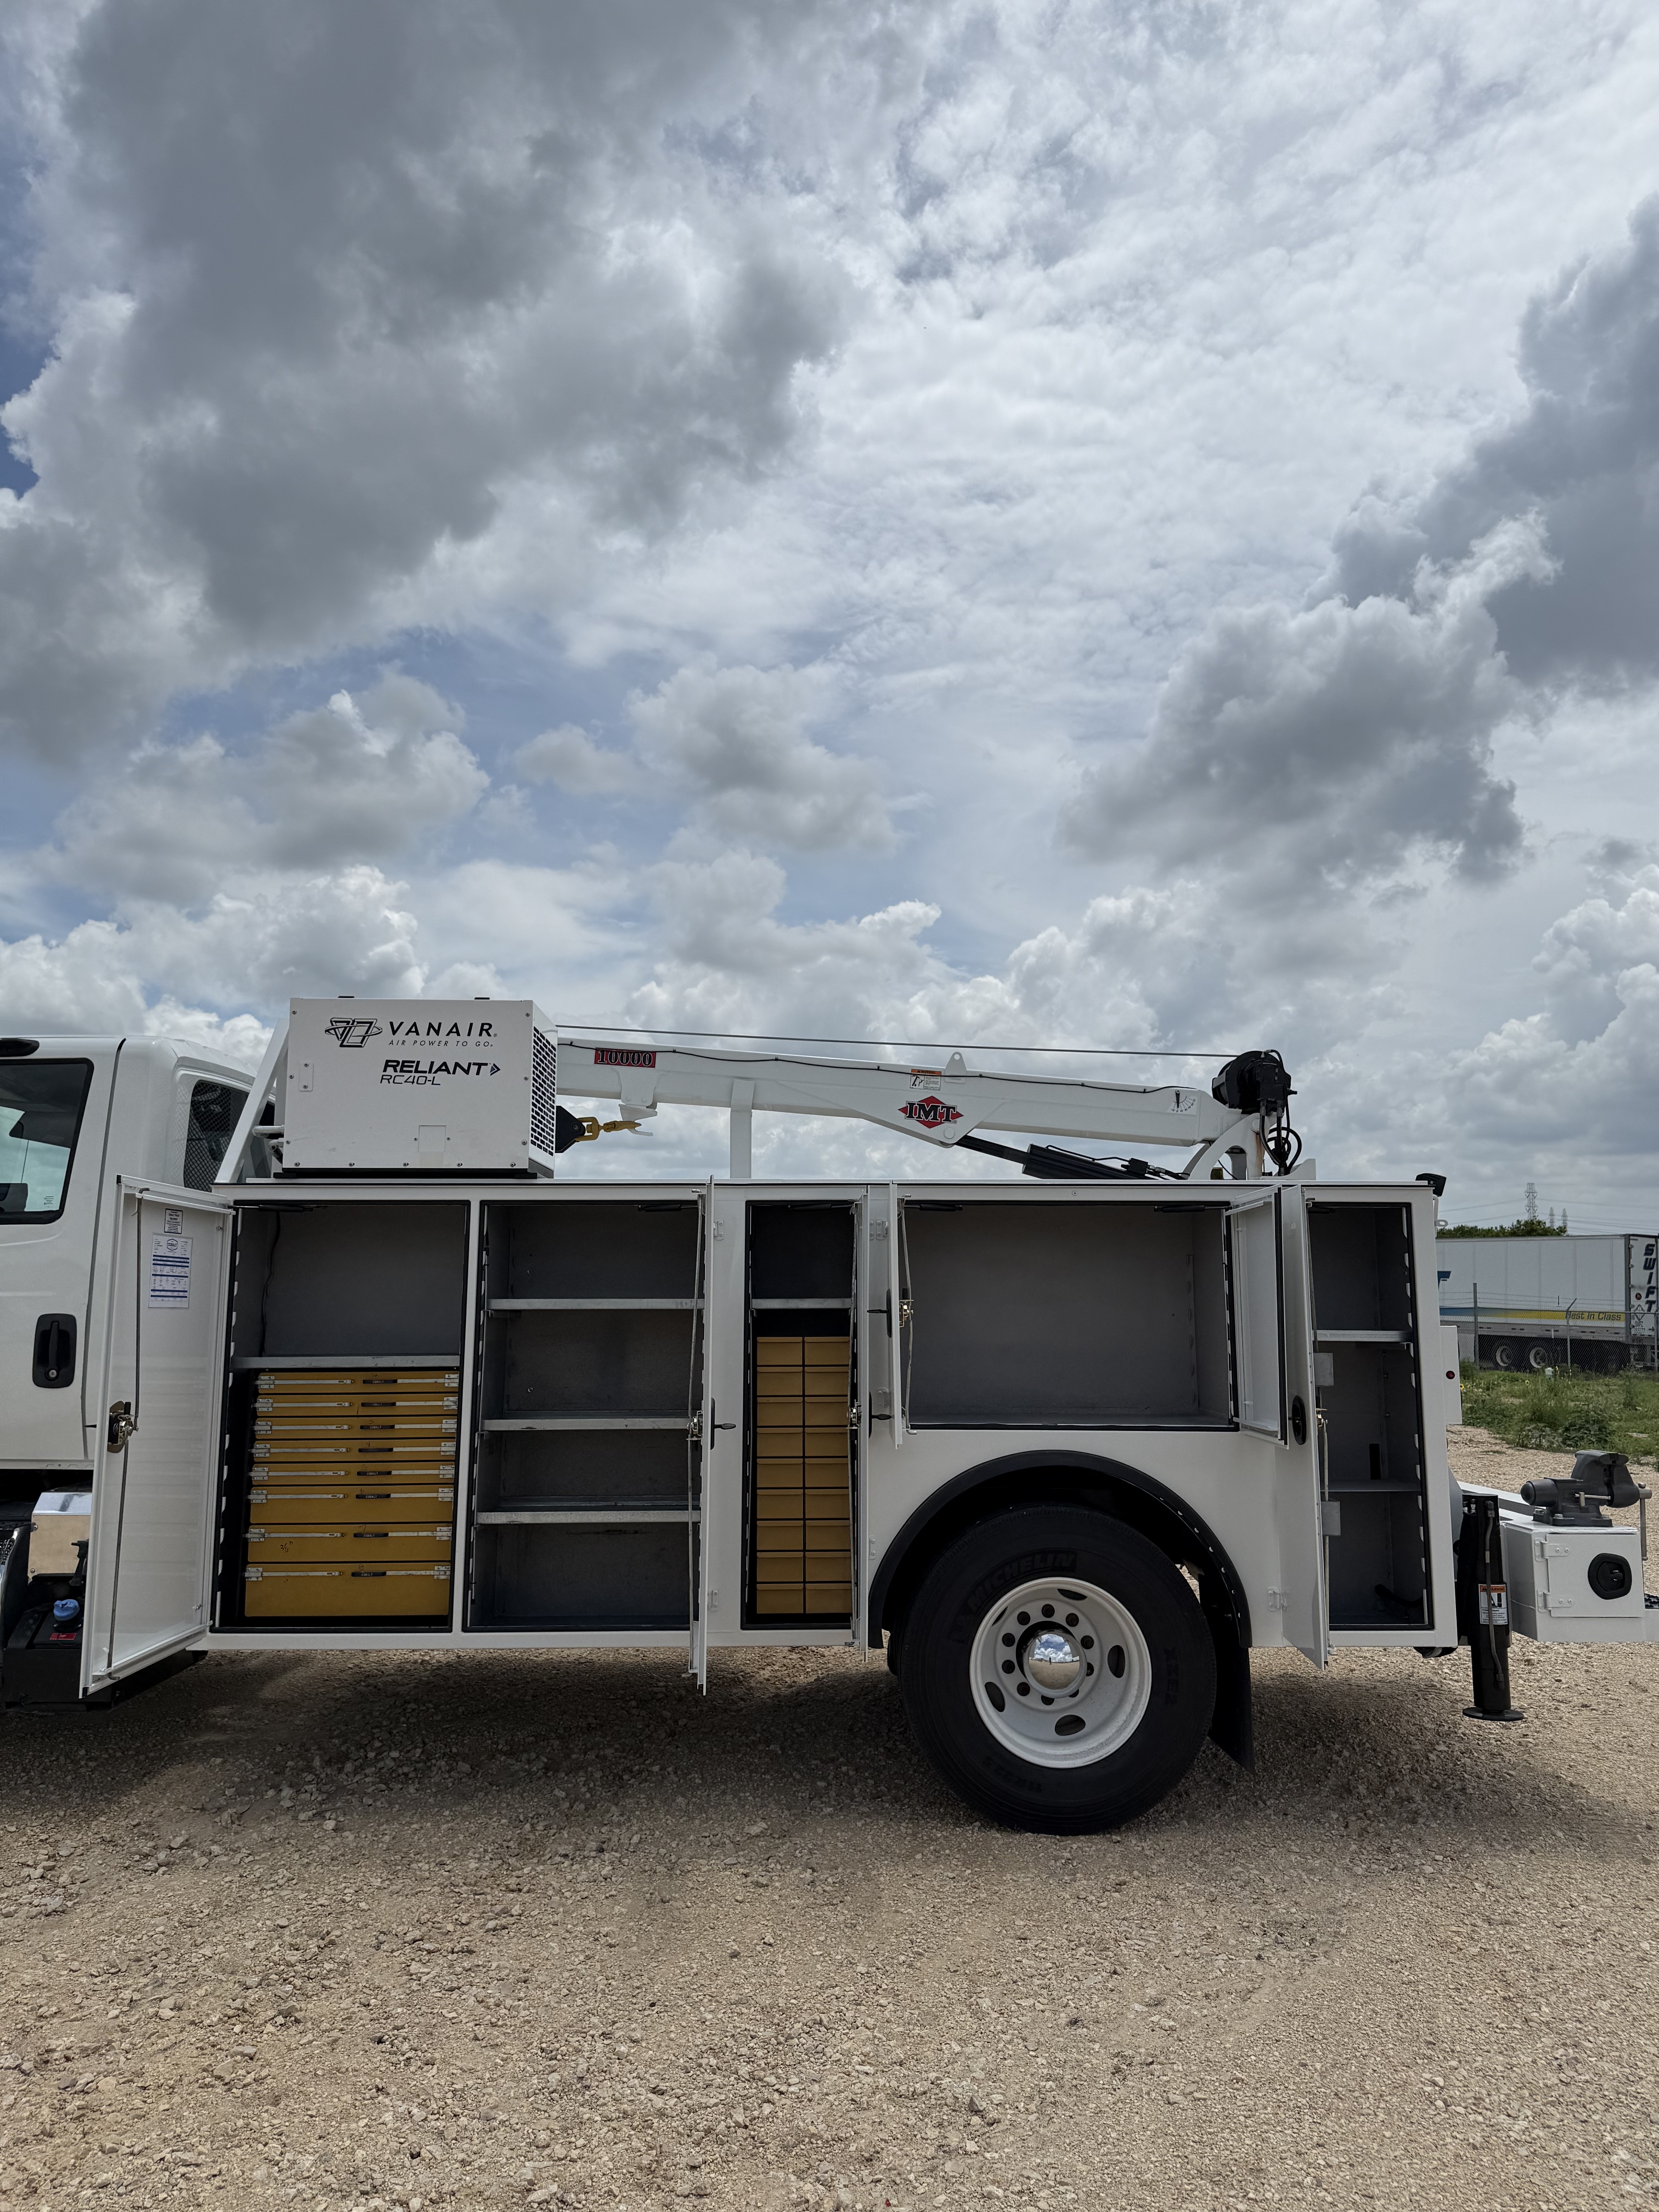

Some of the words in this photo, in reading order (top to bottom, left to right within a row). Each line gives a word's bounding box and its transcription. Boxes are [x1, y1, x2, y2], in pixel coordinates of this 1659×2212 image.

[389, 1021, 493, 1037] VANAIR
[598, 1050, 653, 1066] 10000
[383, 1060, 488, 1075] RELIANT
[380, 1074, 441, 1085] RC40-L
[905, 1101, 957, 1123] IMT
[1643, 1243, 1656, 1312] SWIFT
[1598, 1312, 1621, 1321] Class
[967, 1554, 1075, 1613] MICHELIN
